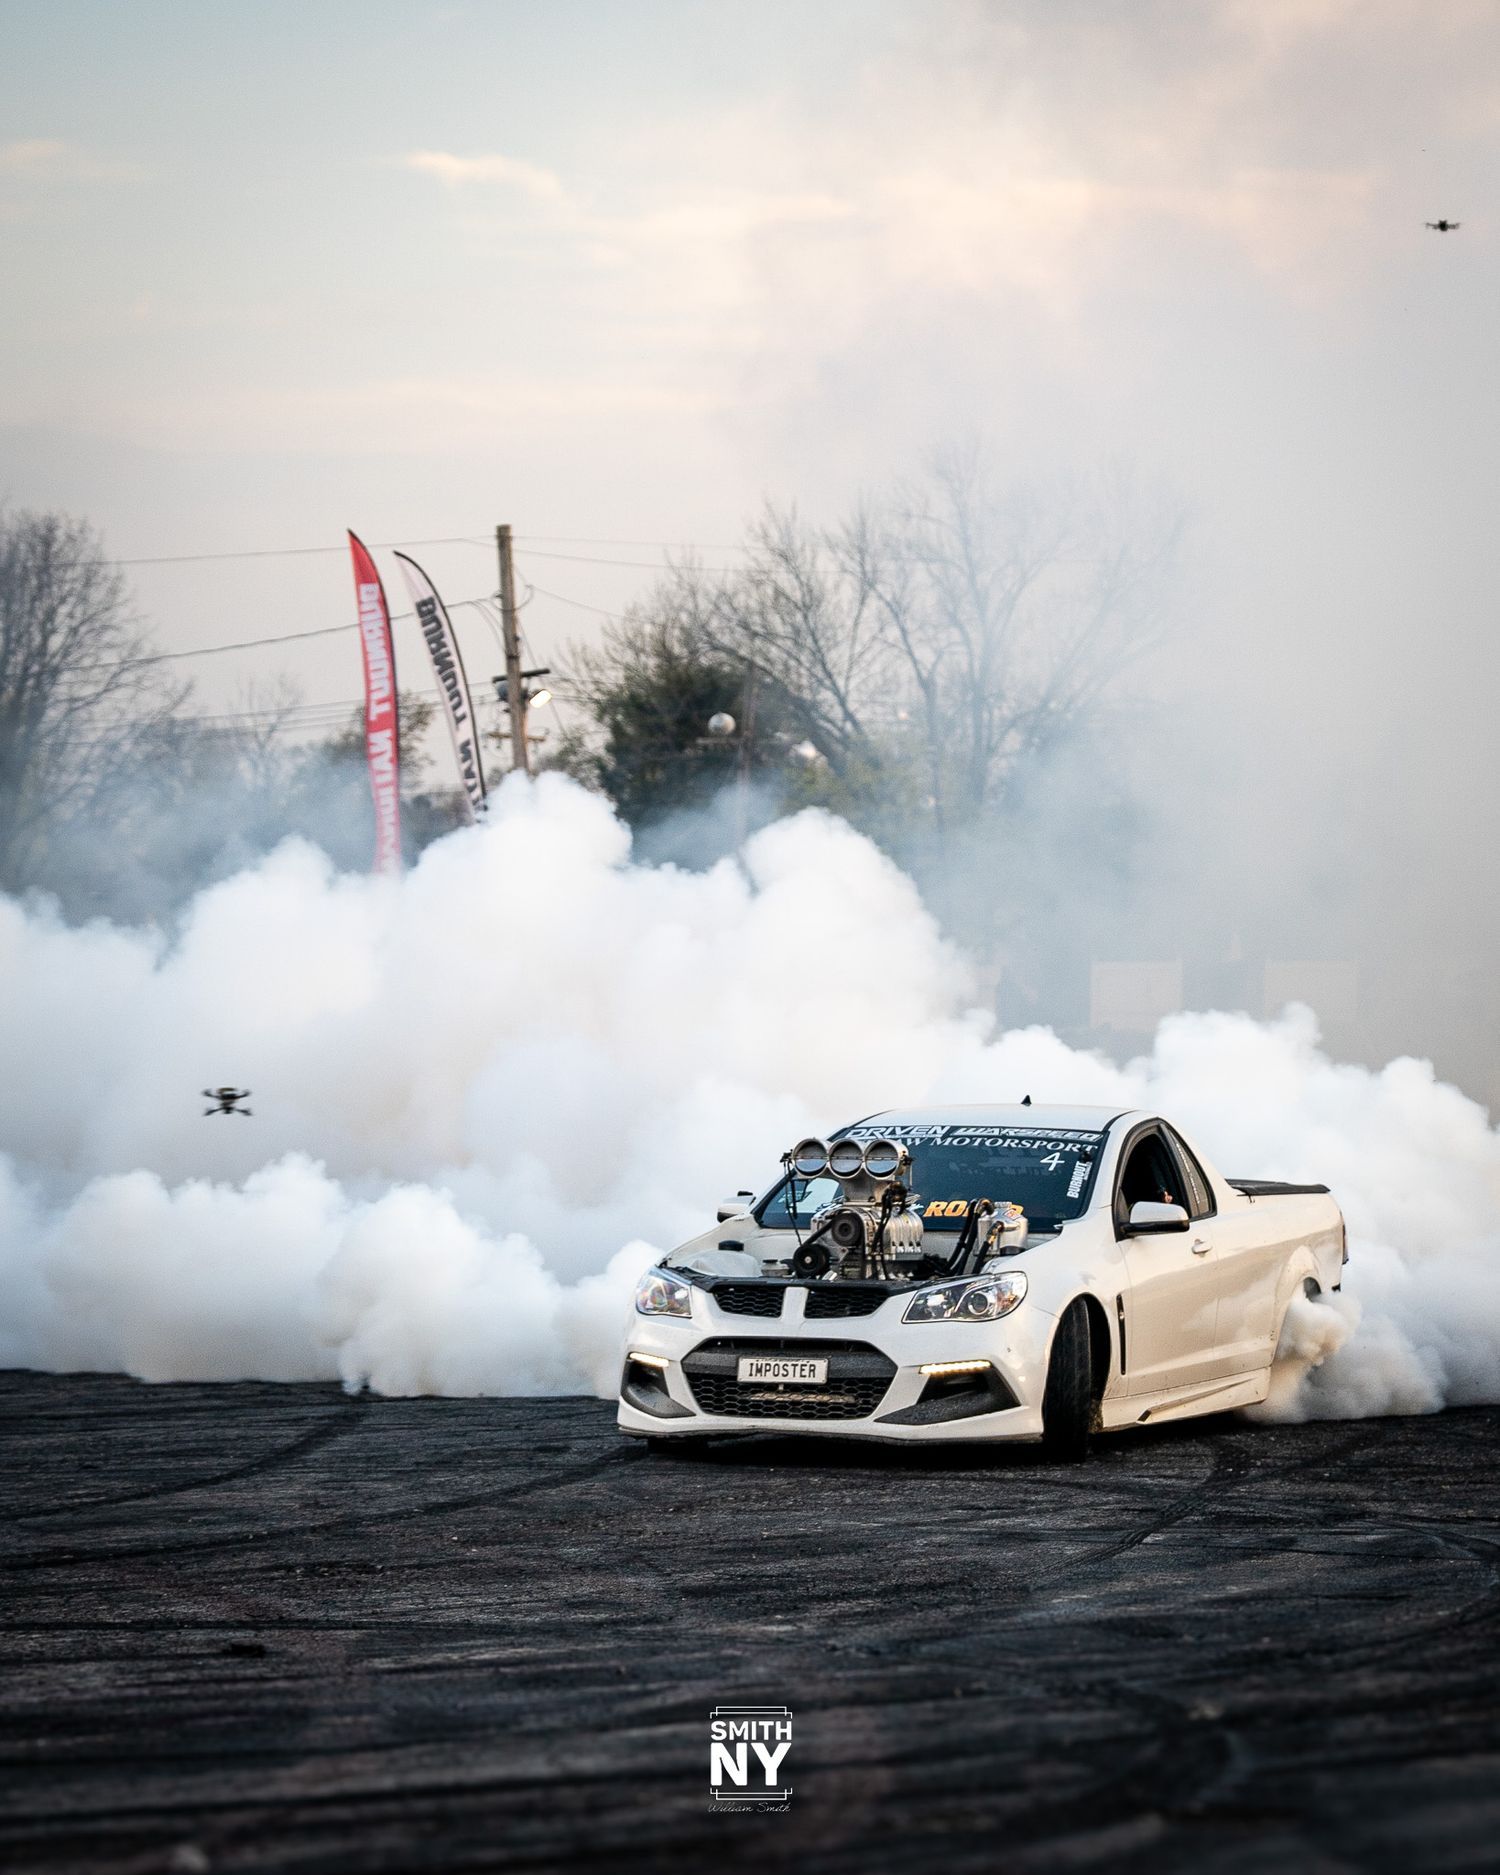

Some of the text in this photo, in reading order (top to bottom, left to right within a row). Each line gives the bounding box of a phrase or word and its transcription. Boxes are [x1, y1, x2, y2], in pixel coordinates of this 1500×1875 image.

[846, 1125, 951, 1141] DRIVEN
[930, 1137, 1099, 1153] MOTORSPORT
[1040, 1152, 1065, 1171] 4
[1066, 1161, 1087, 1198] BURNOUT
[748, 1362, 817, 1379] IMPOSTER
